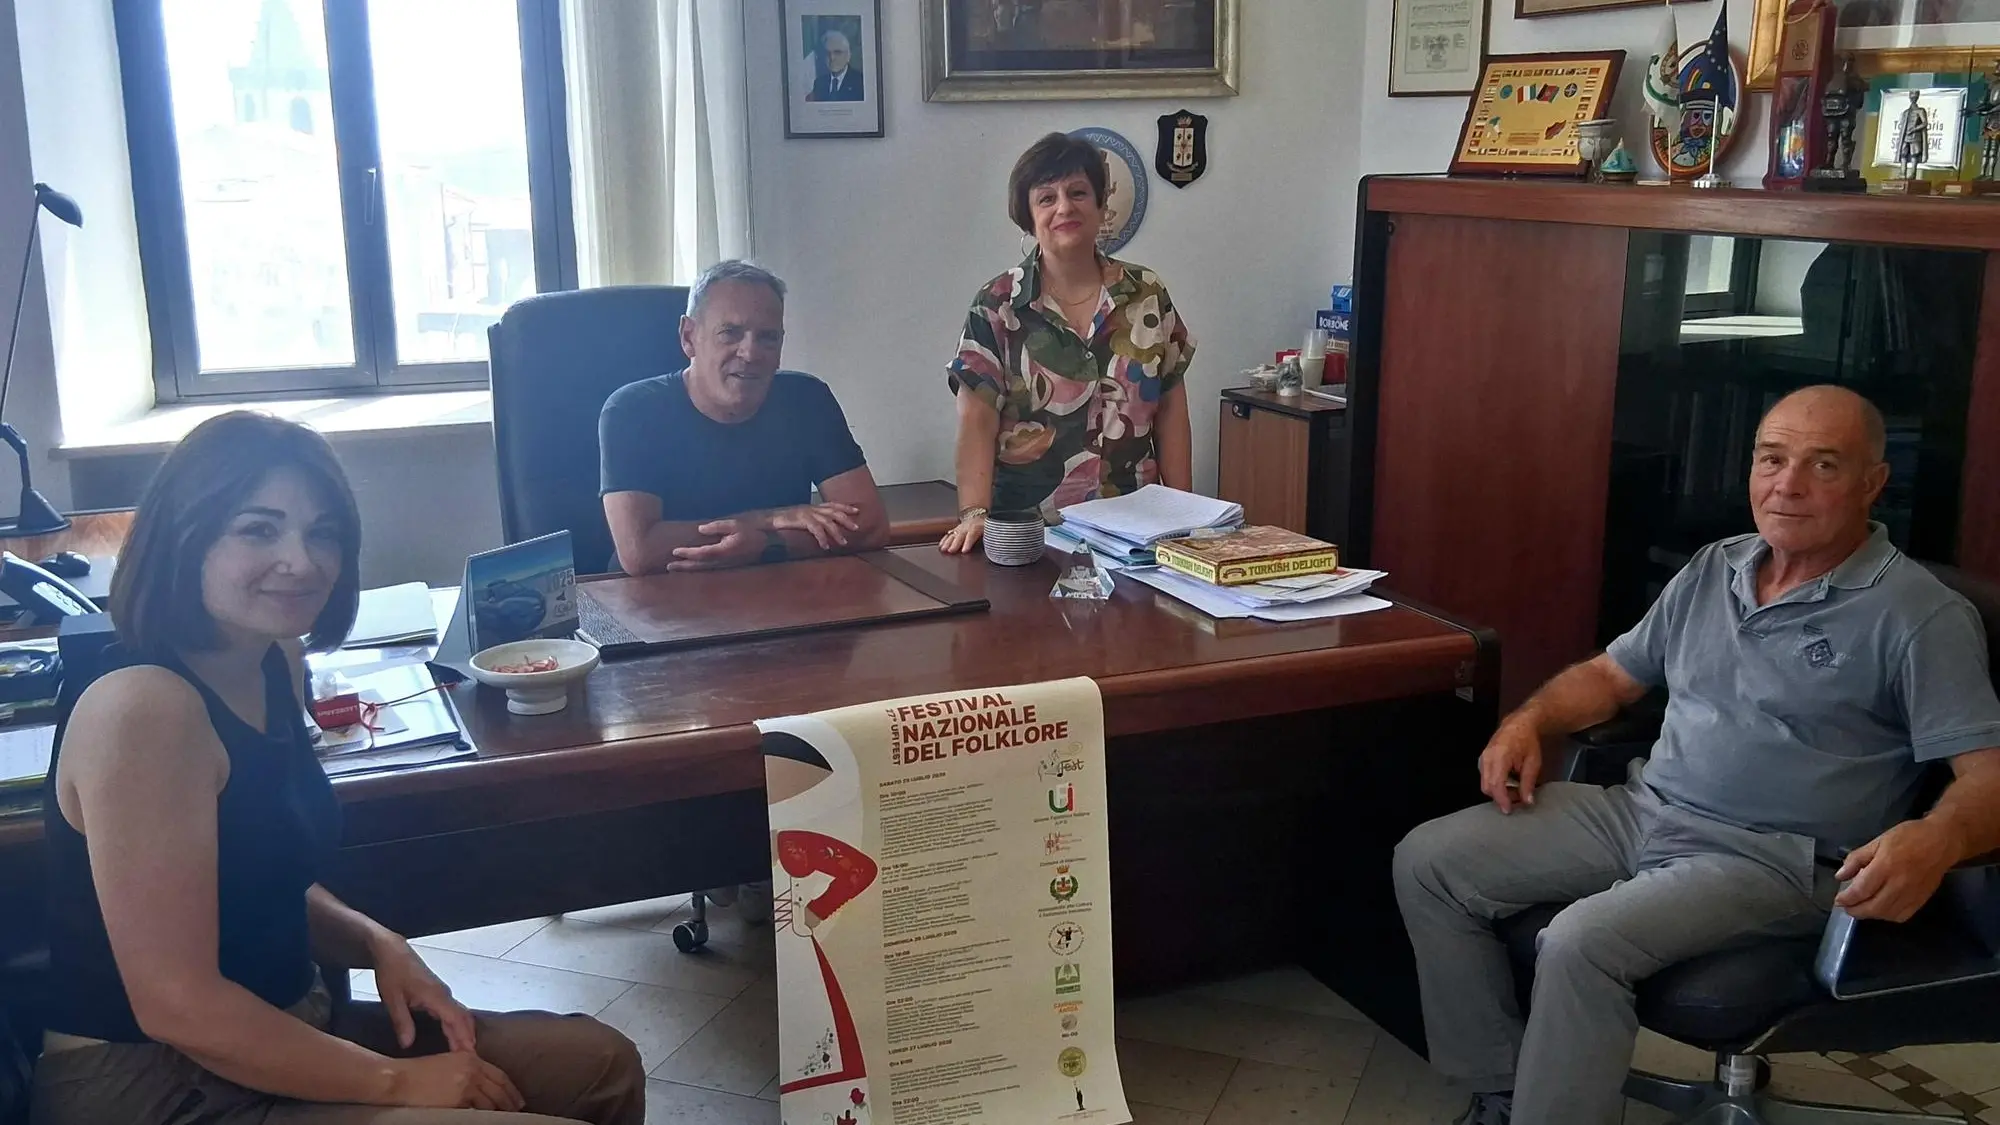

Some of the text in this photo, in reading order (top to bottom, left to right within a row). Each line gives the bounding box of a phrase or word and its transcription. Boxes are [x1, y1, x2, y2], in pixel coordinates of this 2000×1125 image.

[1319, 316, 1350, 331] BORBONE
[1248, 560, 1290, 576] TURKISH
[1292, 557, 1333, 571] DELIGHT
[897, 693, 1012, 722] FESTIVAL
[902, 705, 1037, 744] NAZIONALE
[891, 742, 901, 766] FEST
[903, 721, 1069, 765] DEL FOLKLORE
